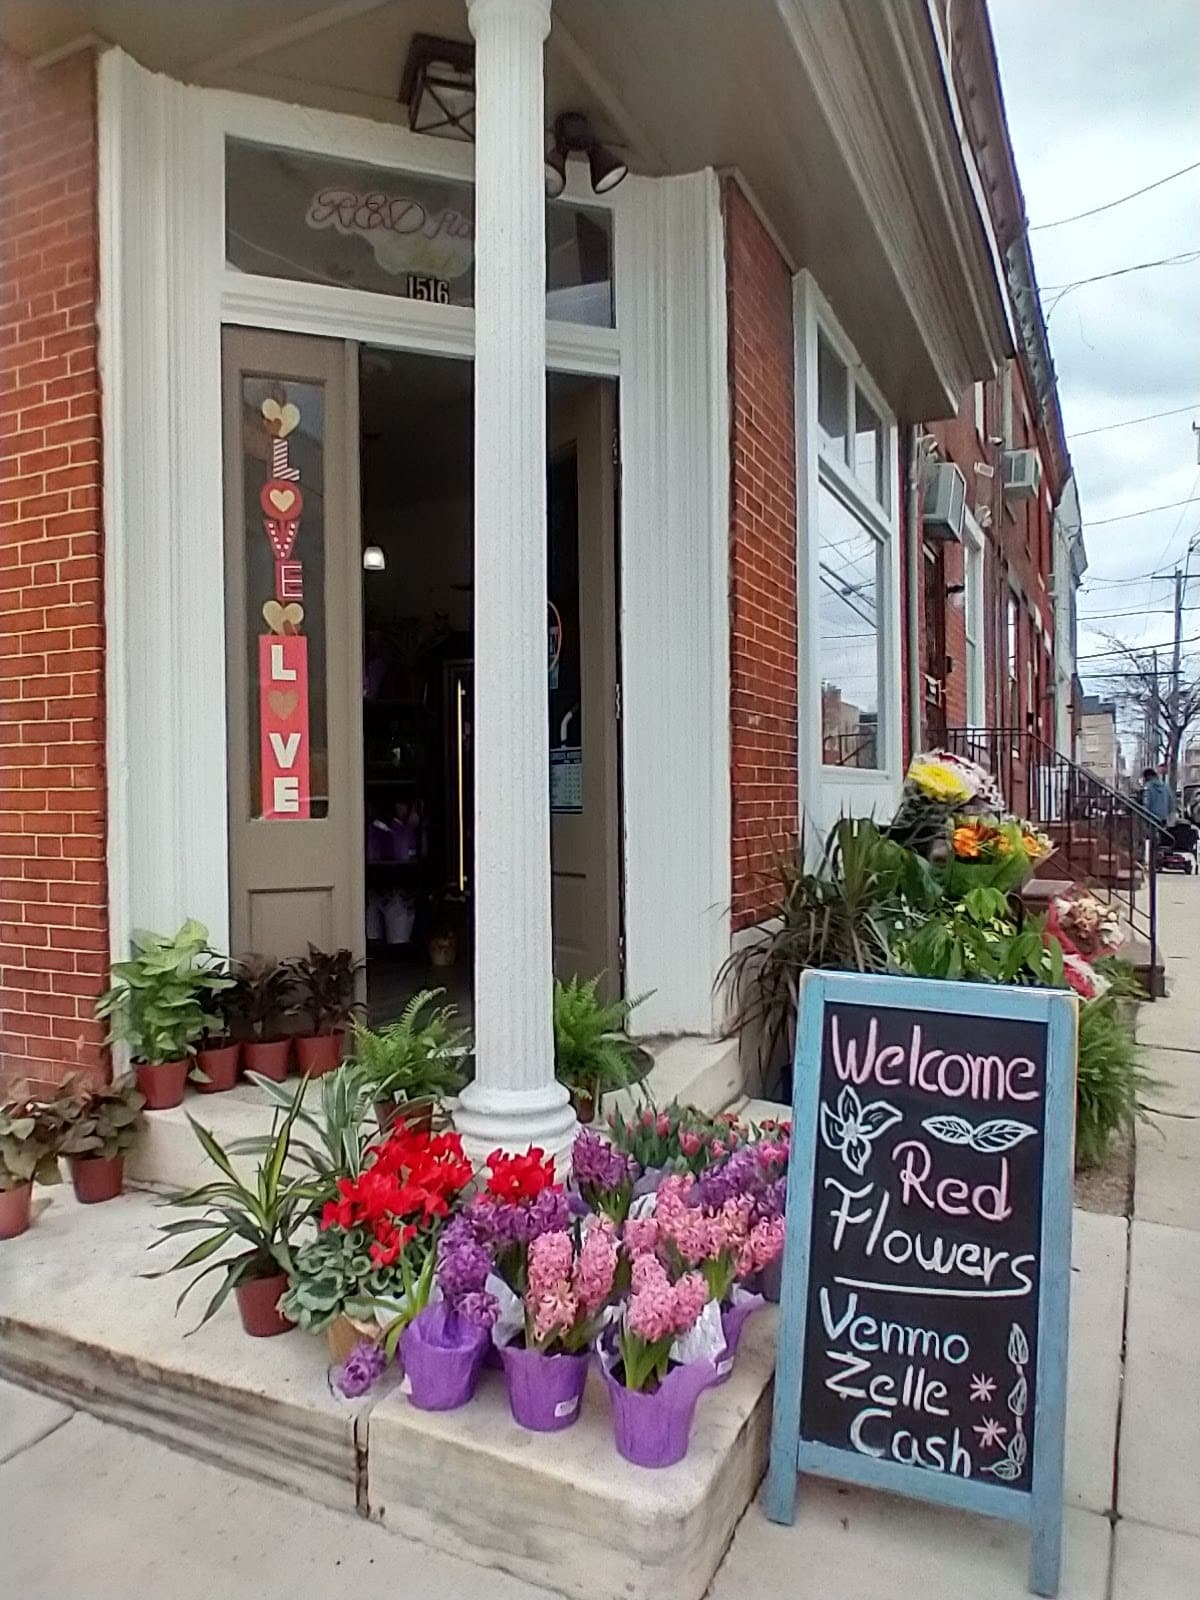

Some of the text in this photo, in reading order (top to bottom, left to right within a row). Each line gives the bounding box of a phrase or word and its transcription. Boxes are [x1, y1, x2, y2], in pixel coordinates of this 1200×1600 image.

[408, 276, 449, 304] 1516
[832, 1014, 1039, 1101] Welcome
[892, 1141, 1012, 1220] Red
[824, 1177, 1035, 1292] Flowers
[820, 1287, 969, 1364] Venmo
[825, 1350, 949, 1416] Zelle
[850, 1408, 971, 1478] Cash
